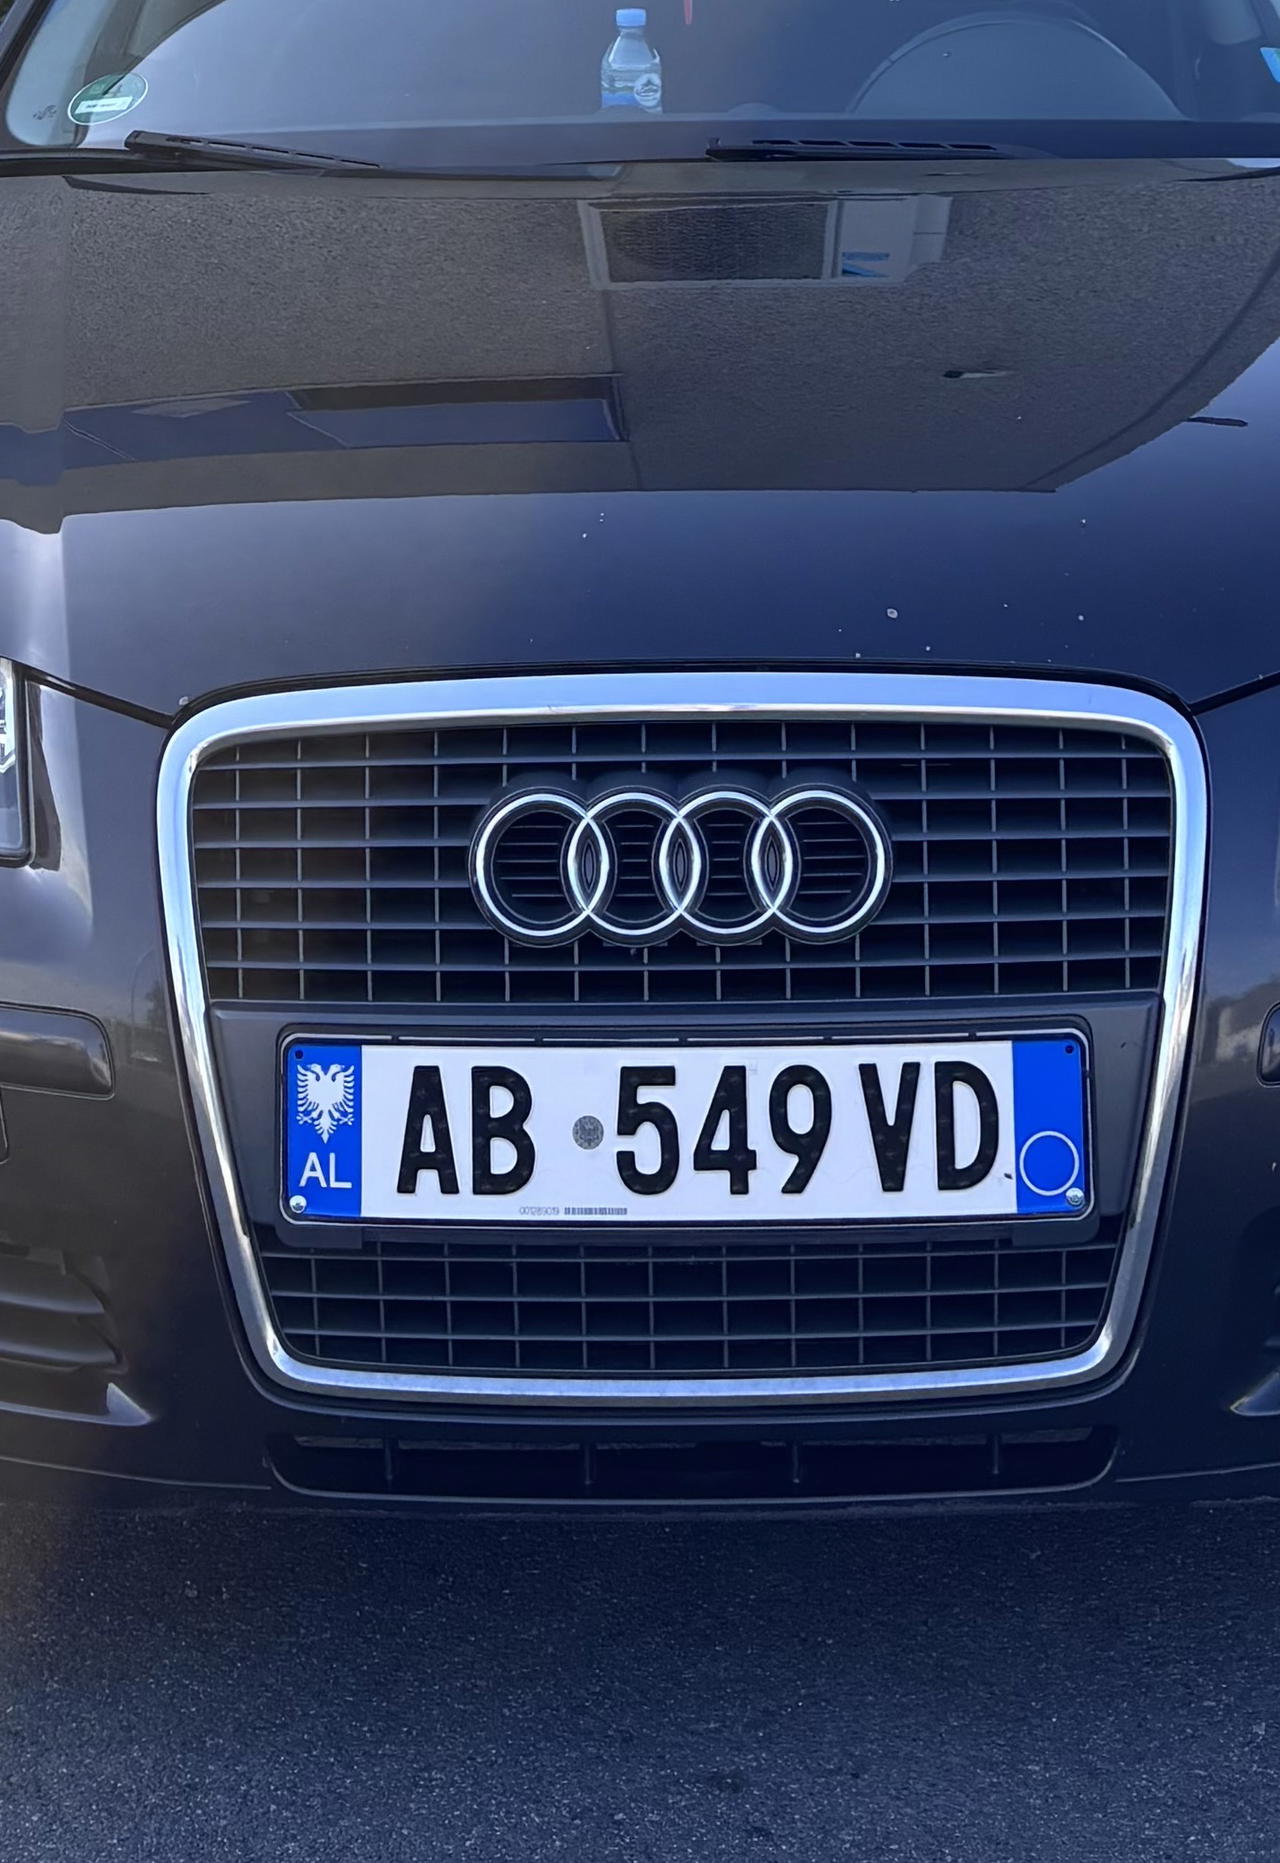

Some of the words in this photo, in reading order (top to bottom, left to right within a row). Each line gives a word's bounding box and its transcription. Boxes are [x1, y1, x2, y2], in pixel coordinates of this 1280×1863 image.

[300, 1153, 352, 1189] AL
[396, 1065, 536, 1196] AB
[616, 1064, 833, 1196] 549
[858, 1060, 1000, 1193] VD
